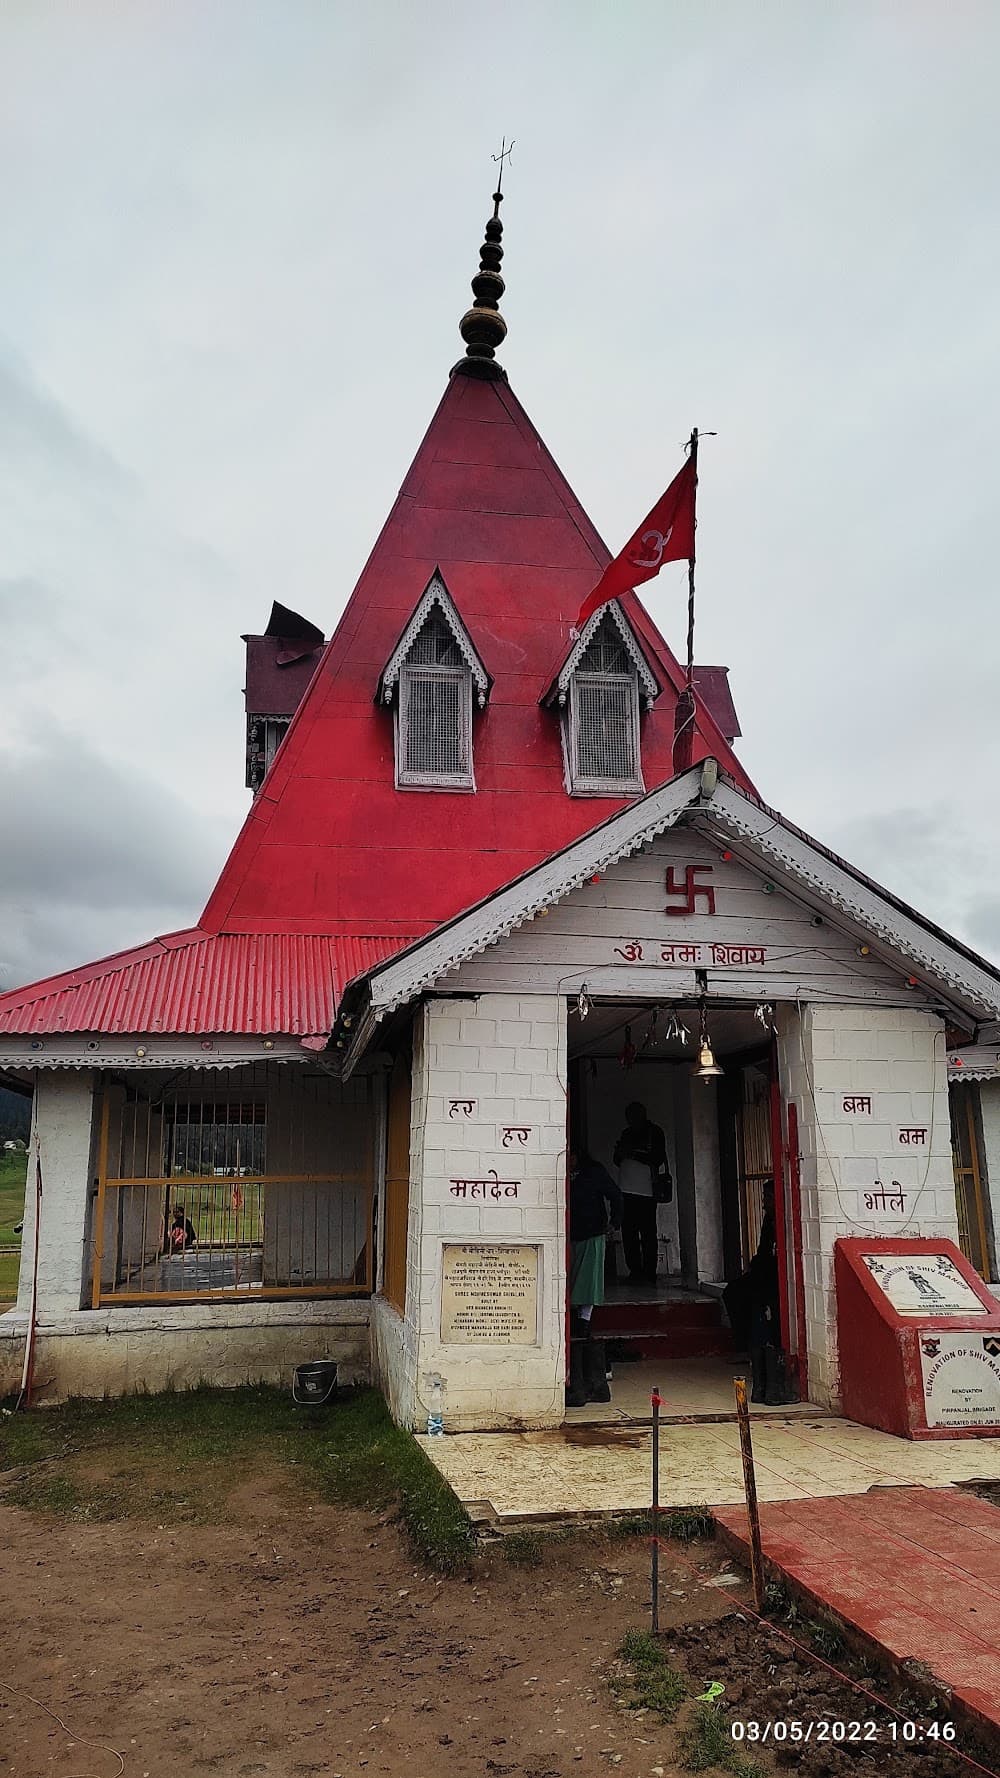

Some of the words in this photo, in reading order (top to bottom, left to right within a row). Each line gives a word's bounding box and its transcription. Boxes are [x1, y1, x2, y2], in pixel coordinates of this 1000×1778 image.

[660, 943, 702, 963] नमः
[708, 942, 768, 966] शिवाय
[448, 1100, 476, 1119] हर
[842, 1096, 872, 1115] बम
[502, 1127, 532, 1148] हर
[898, 1128, 928, 1145] बम
[449, 1169, 522, 1201] महादेव
[863, 1180, 908, 1213] भोले
[916, 1265, 936, 1273] SHIV
[925, 1351, 956, 1397] RENOVATION
[957, 1349, 967, 1357] OF
[969, 1349, 988, 1362] SHIV
